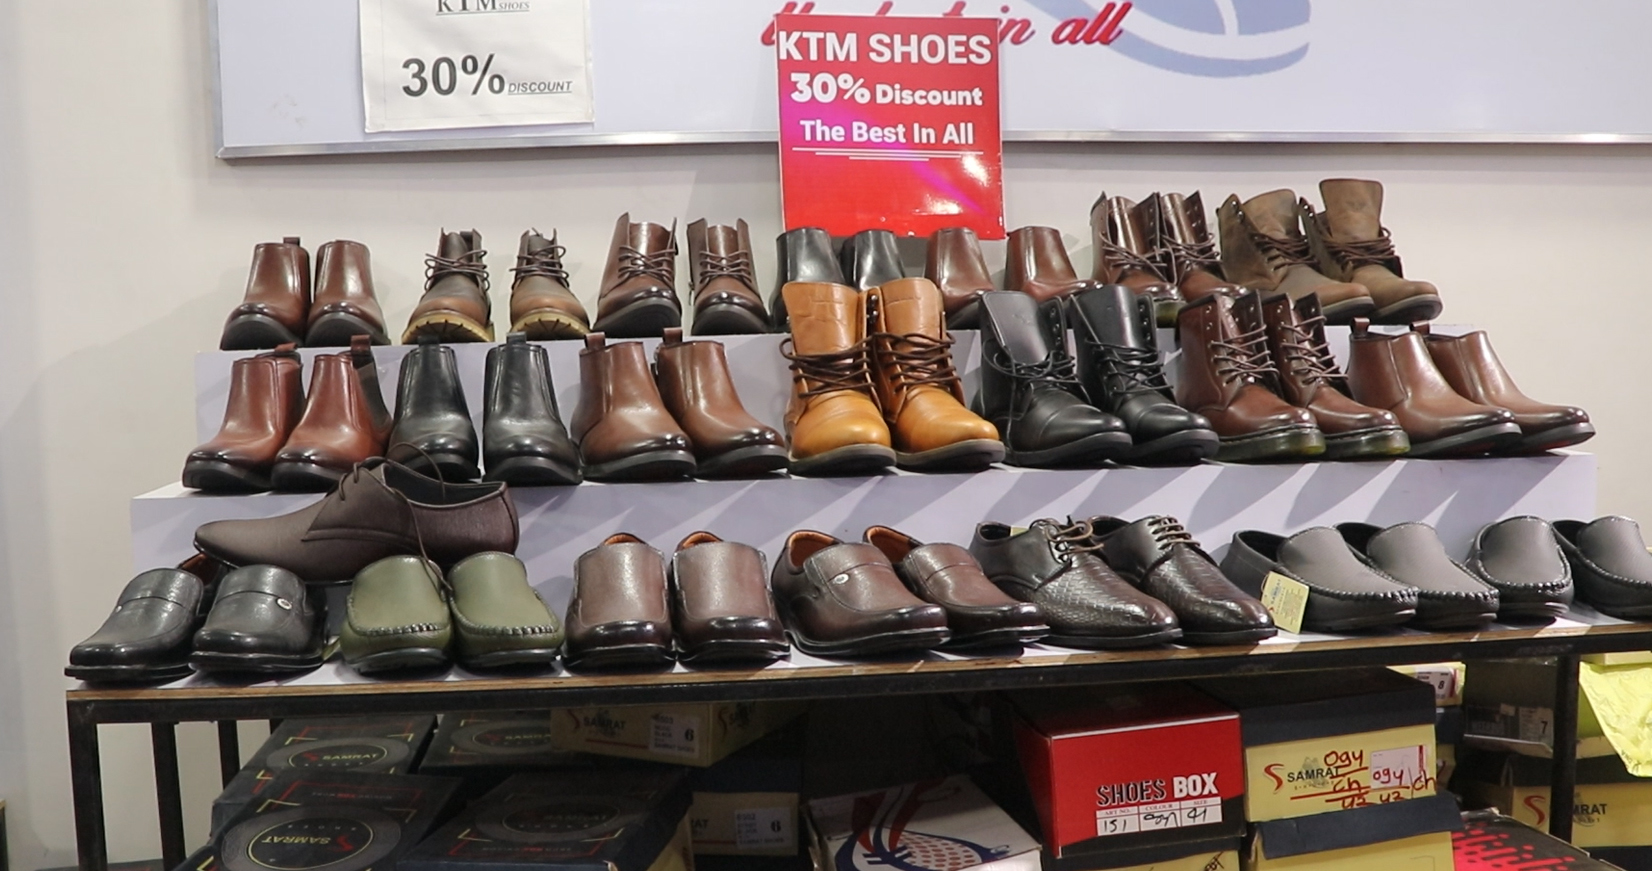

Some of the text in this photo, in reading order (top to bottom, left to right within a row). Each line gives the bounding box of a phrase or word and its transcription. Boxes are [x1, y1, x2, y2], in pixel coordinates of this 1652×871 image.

[1052, 1, 1133, 46] all
[778, 31, 992, 65] KTM SHOES
[402, 54, 573, 97] 30% DISCOUNT
[790, 72, 984, 107] 30% Discount
[799, 119, 975, 146] The Best In All
[685, 729, 695, 742] 6
[1540, 720, 1549, 735] 7
[321, 753, 379, 761] SAMRAT
[1287, 765, 1341, 783] SAMRAT
[1096, 771, 1219, 807] SHOES BOX
[1145, 804, 1174, 812] COLOUR
[770, 819, 782, 833] 6
[261, 835, 334, 846] SAMRAT
